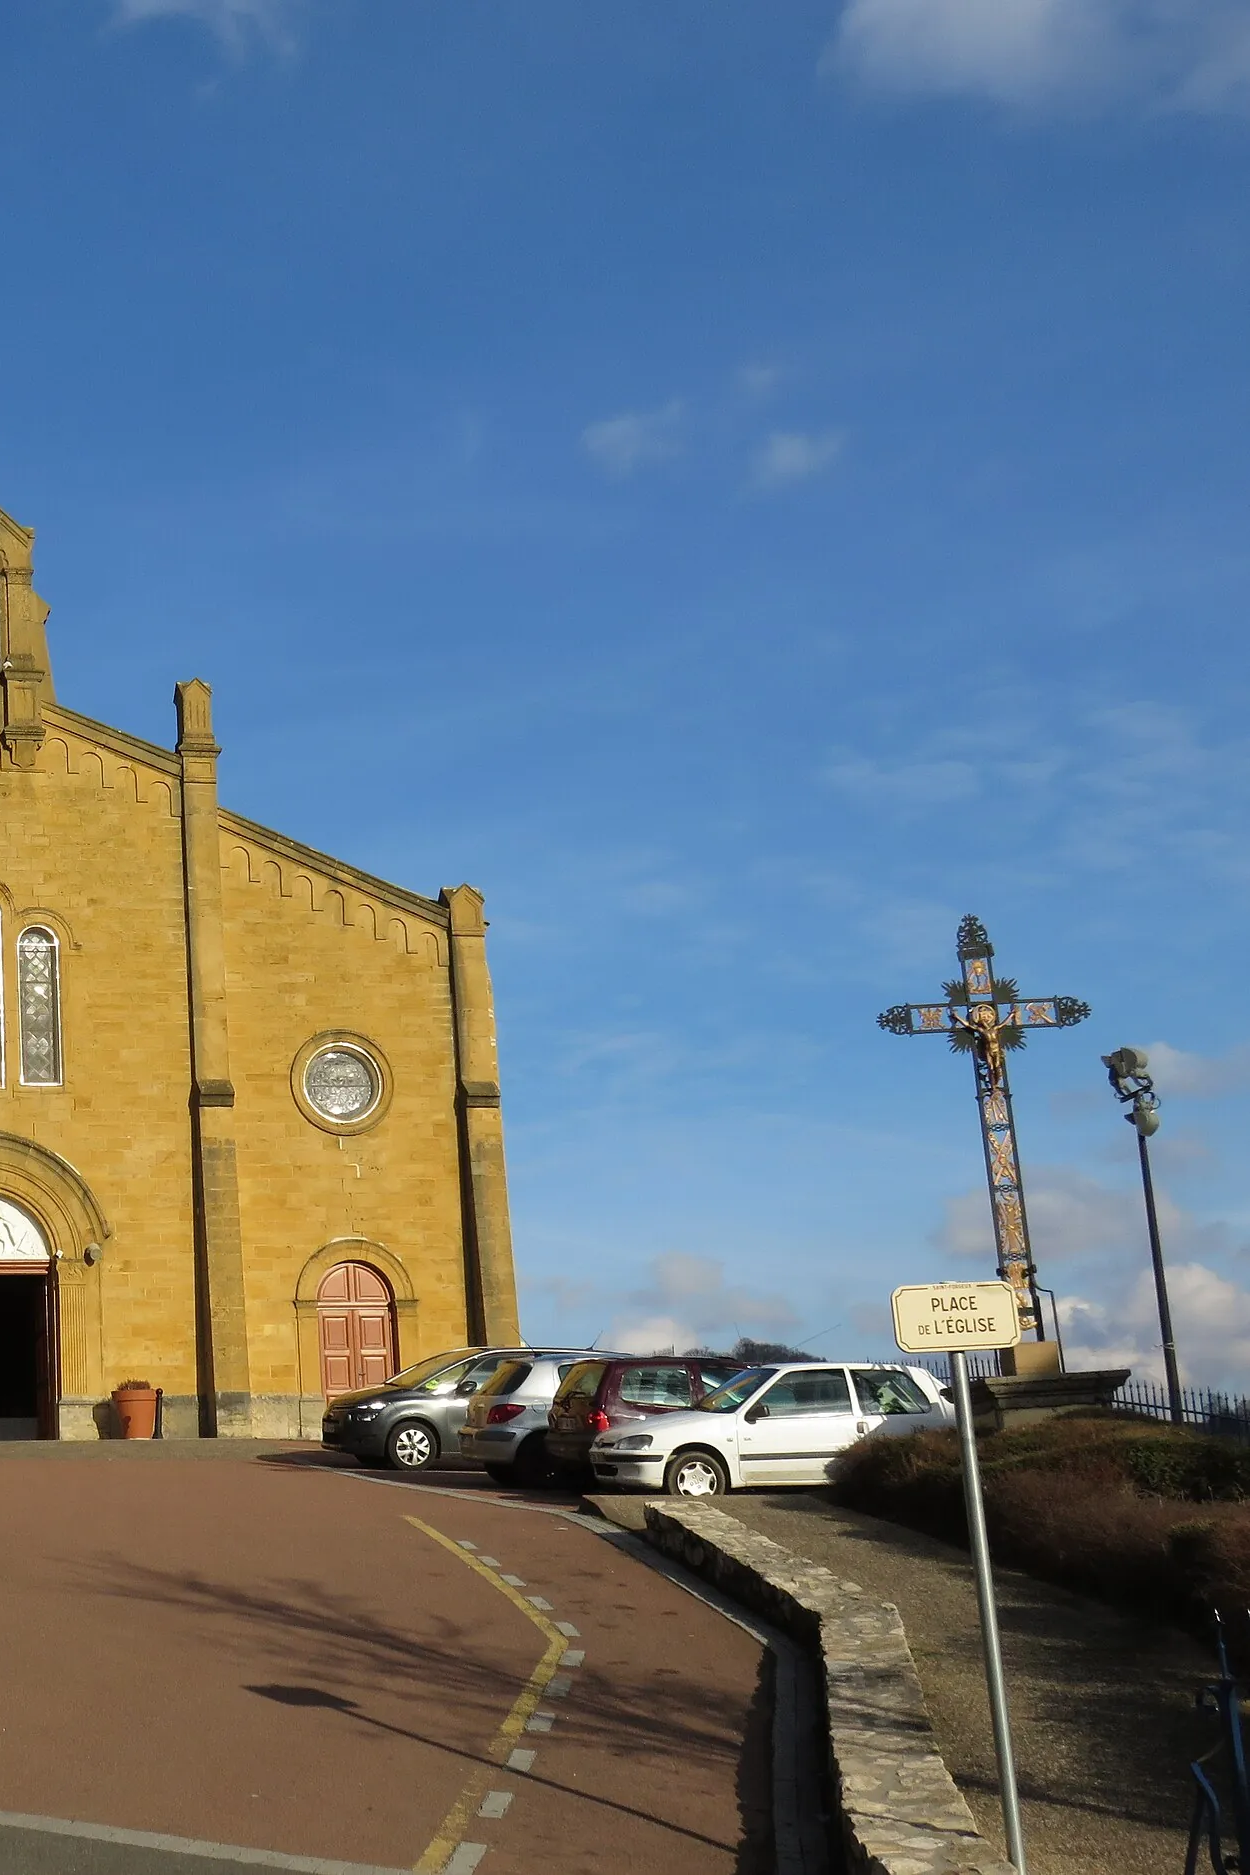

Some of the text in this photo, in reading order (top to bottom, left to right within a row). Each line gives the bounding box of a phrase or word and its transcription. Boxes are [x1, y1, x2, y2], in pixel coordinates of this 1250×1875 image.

[931, 1296, 978, 1312] PLACE
[918, 1316, 996, 1335] DE L'ÉGLISE
